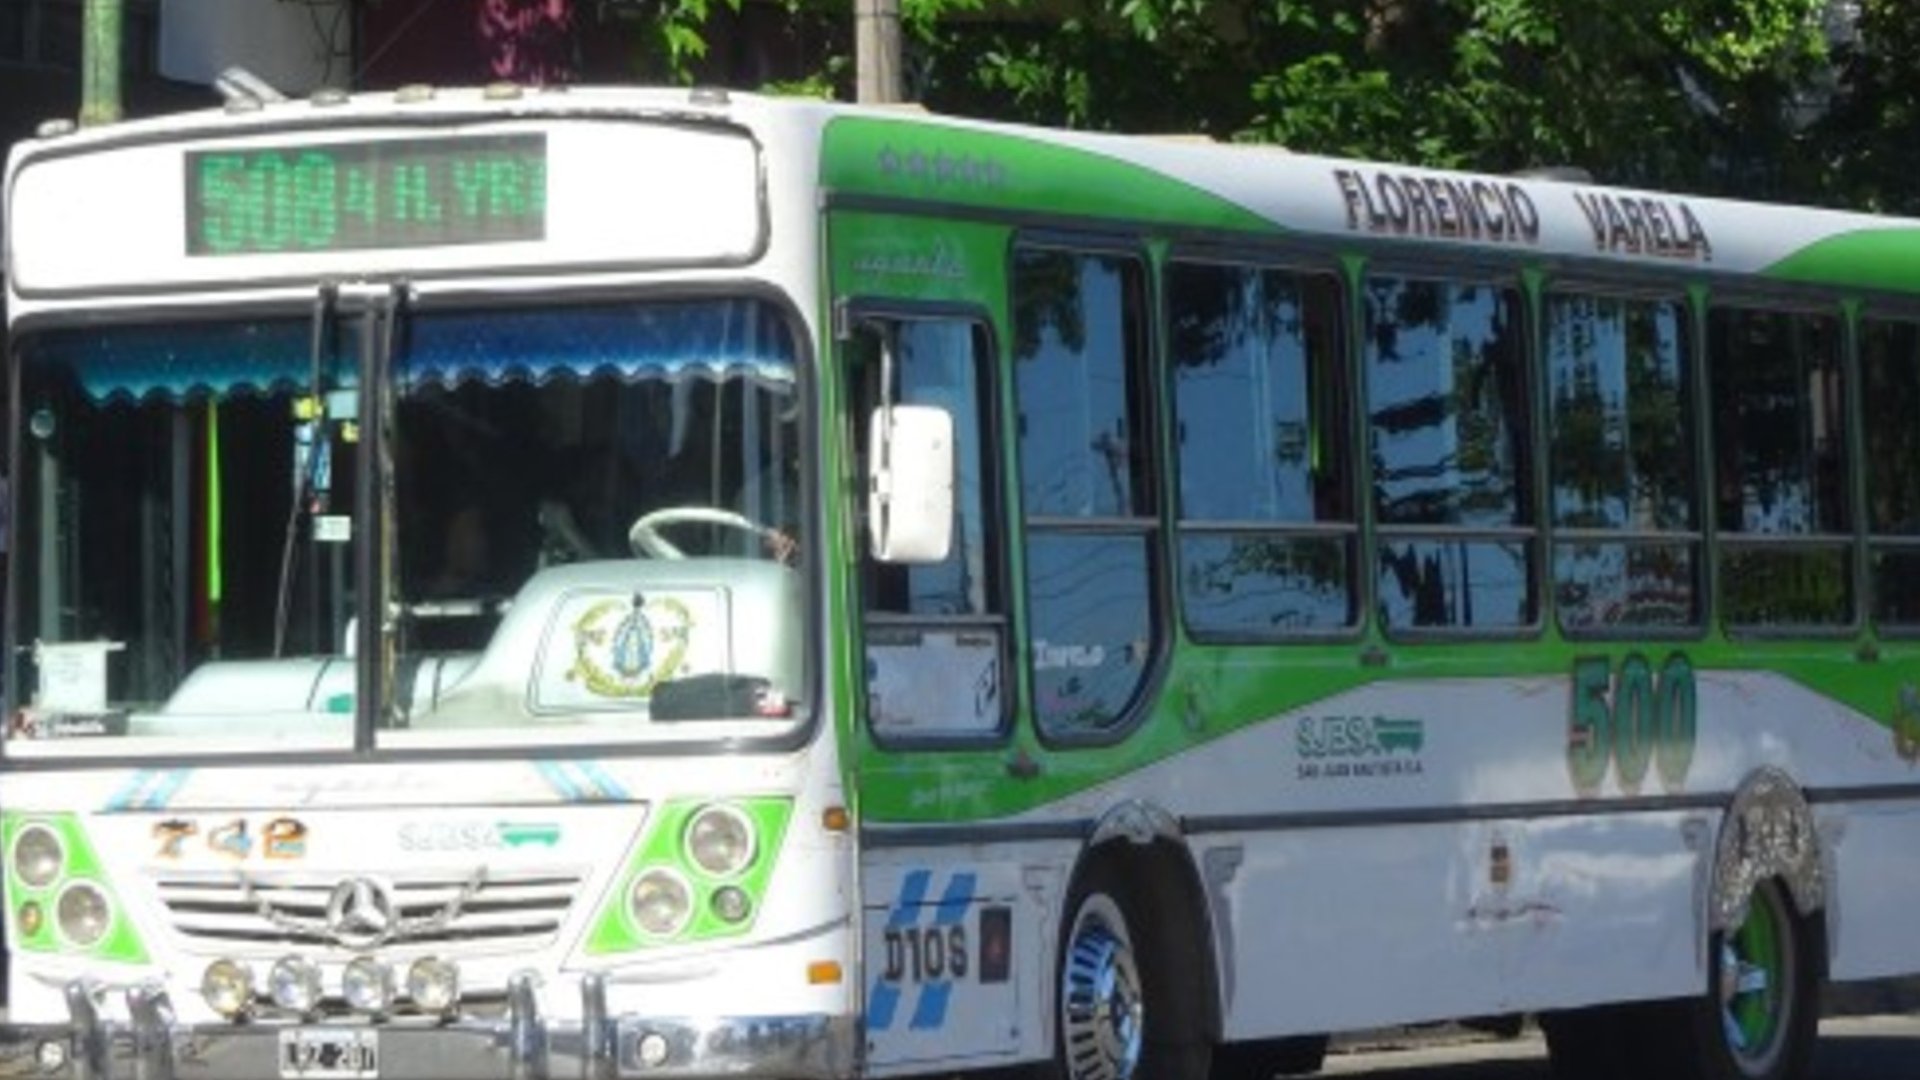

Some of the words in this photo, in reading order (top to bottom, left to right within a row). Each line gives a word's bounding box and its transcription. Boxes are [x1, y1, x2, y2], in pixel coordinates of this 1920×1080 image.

[1333, 168, 1540, 244] FLORENCIO
[1573, 188, 1713, 262] VARELA
[1566, 649, 1697, 799] 500
[152, 817, 308, 860] 742
